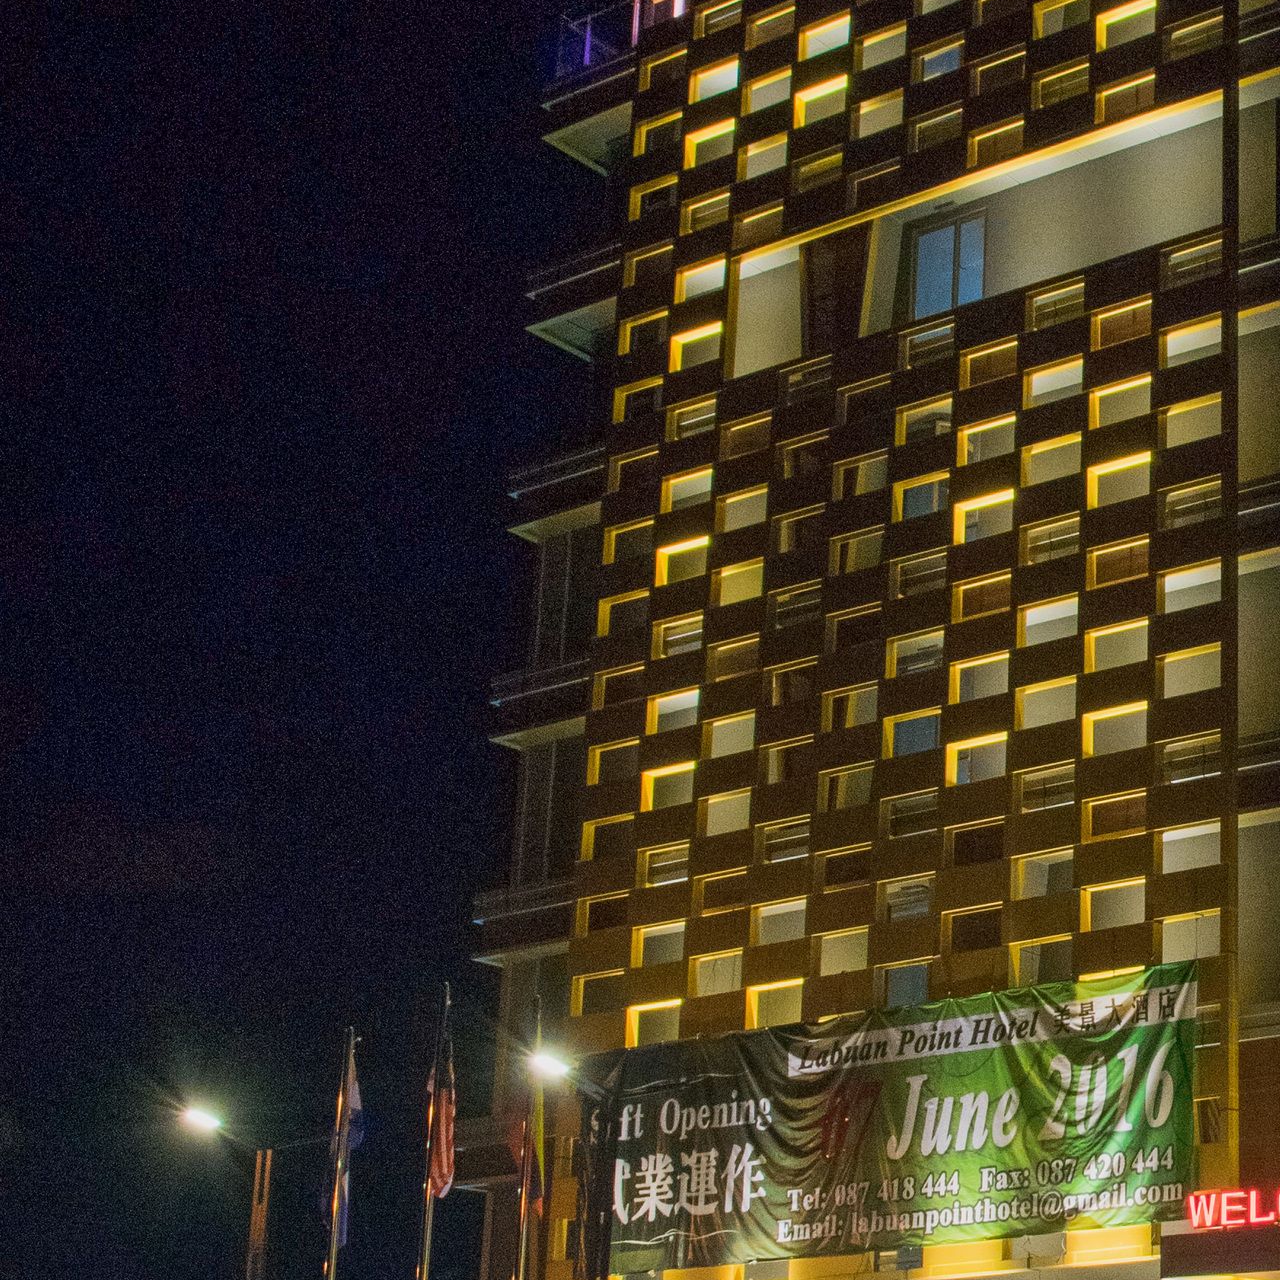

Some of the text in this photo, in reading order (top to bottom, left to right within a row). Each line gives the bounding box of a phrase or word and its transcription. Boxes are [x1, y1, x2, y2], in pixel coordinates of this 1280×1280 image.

[799, 1010, 1040, 1071] Labuan Point Hotel
[1054, 988, 1179, 1035] 美景大酒店
[660, 1090, 772, 1140] Opening
[887, 1074, 1020, 1161] June
[1037, 1038, 1176, 1142] 2016
[787, 1146, 1174, 1213] Tel: 087 418 444 Fax: 087 420 444
[776, 1182, 1184, 1244] Email: labuanpointhotel@gmail.com
